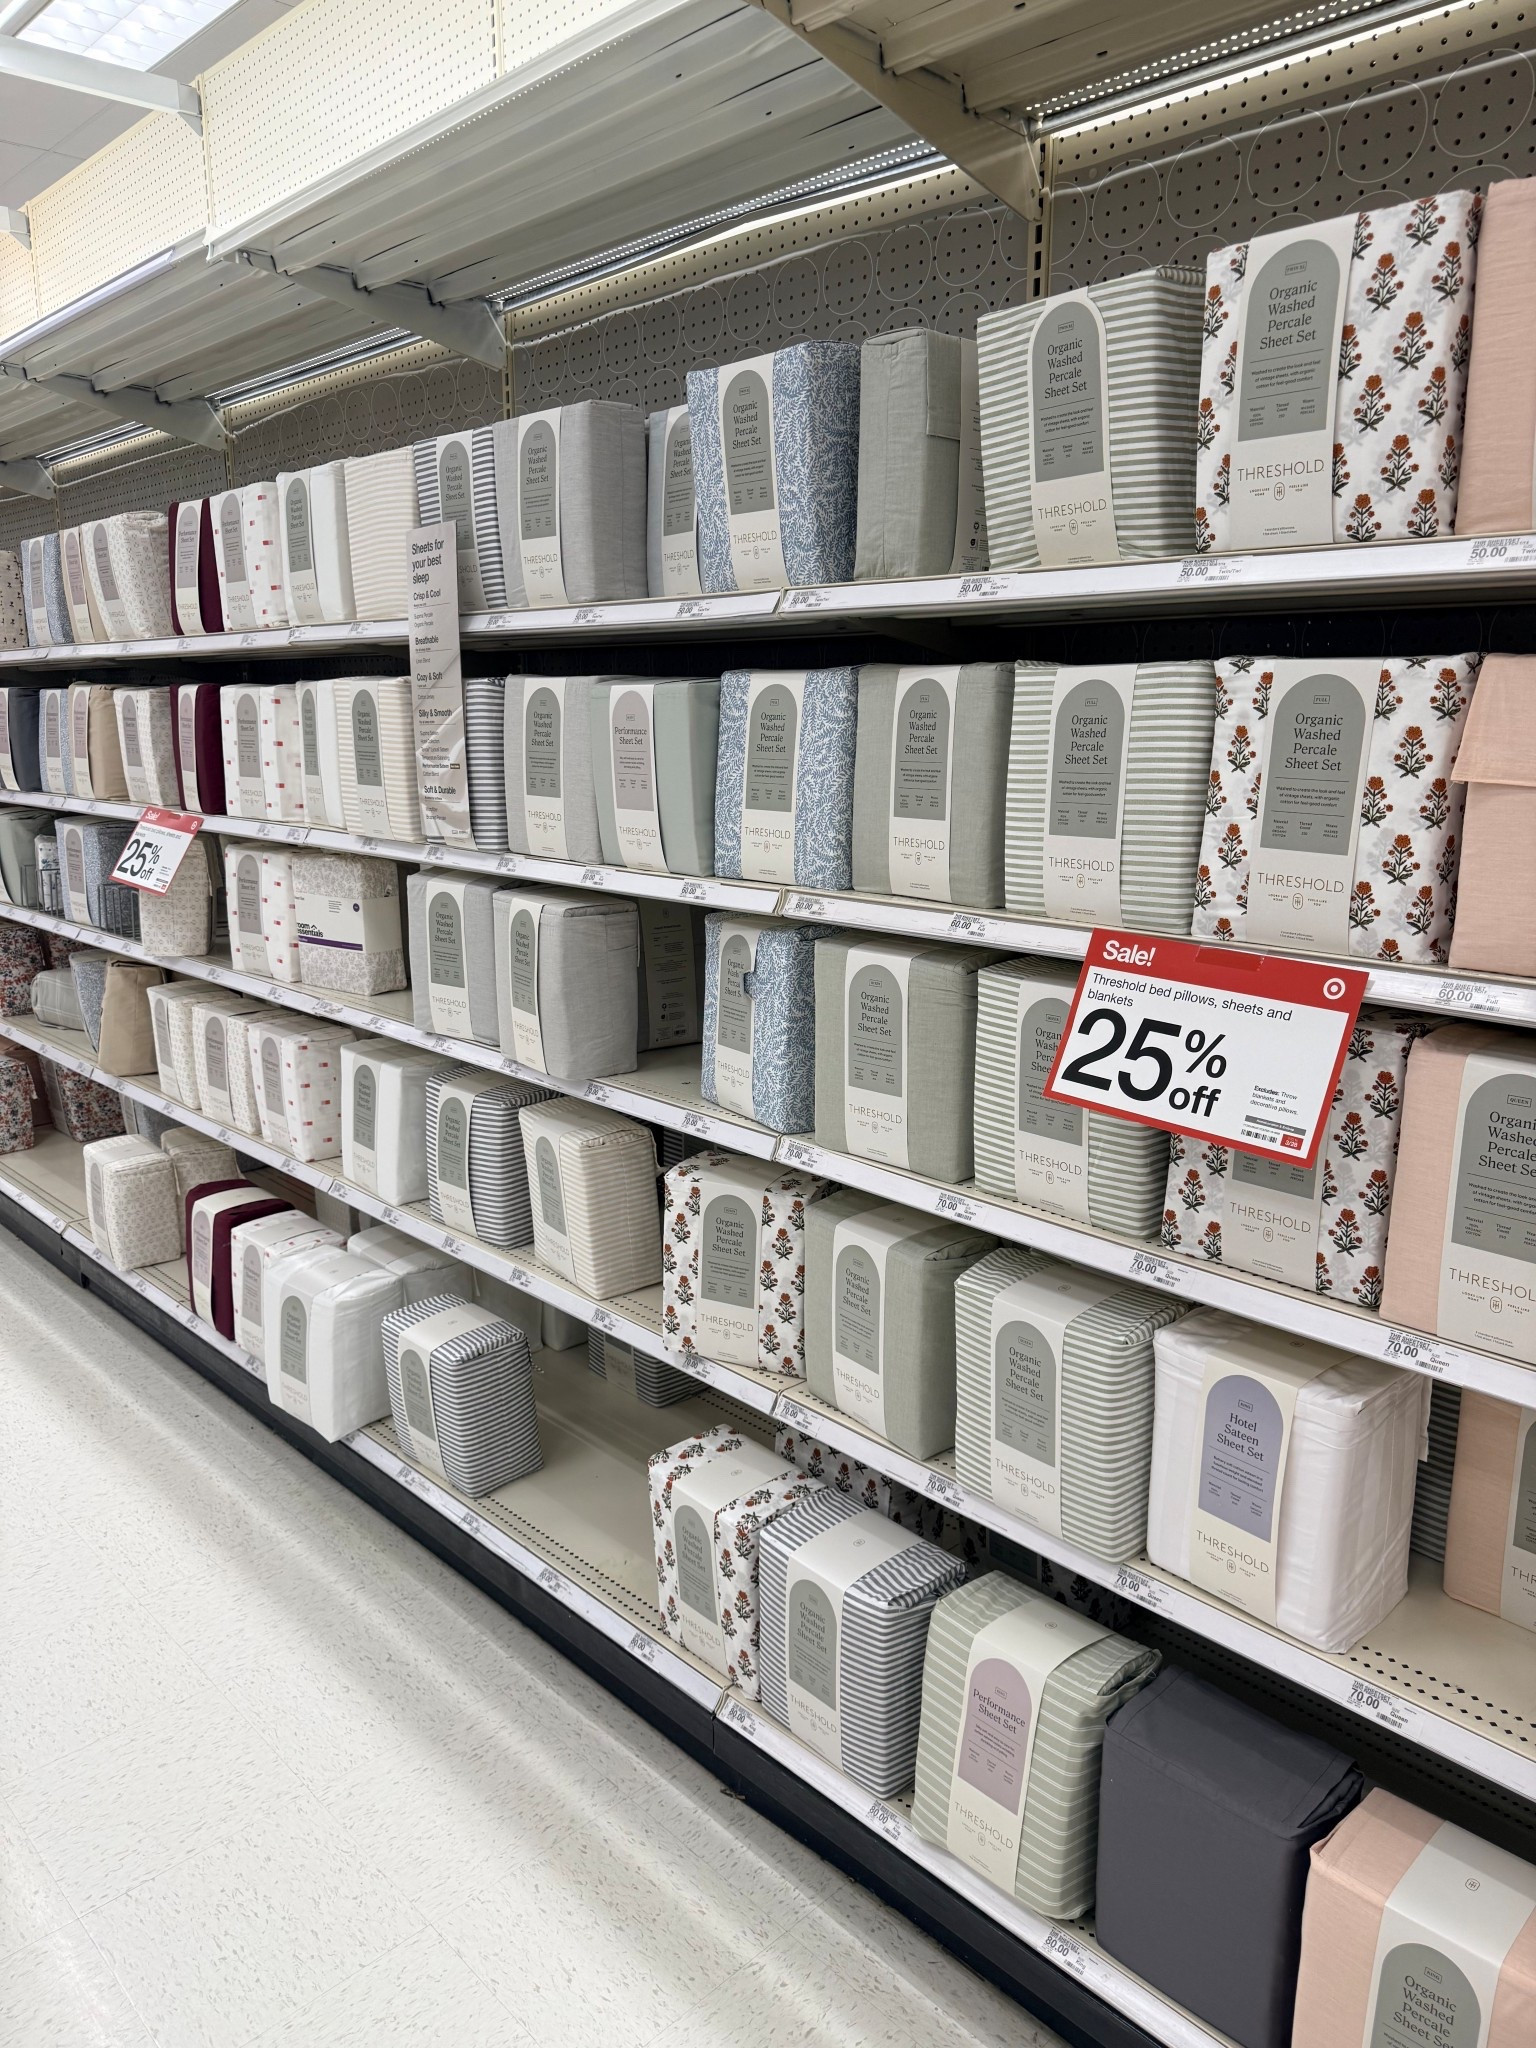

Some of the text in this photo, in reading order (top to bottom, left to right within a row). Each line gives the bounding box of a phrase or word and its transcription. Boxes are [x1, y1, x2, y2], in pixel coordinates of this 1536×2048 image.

[1270, 280, 1317, 300] Organic
[1268, 296, 1315, 315] Washed
[1268, 314, 1311, 332] Percale
[1048, 338, 1082, 355] Organic
[1260, 330, 1316, 349] Sheet Set
[1048, 352, 1082, 369] Washed
[1049, 367, 1082, 383] Percale
[1045, 381, 1087, 398] Sheet Set
[733, 401, 757, 415] Organic
[734, 412, 757, 425] Washed
[735, 425, 757, 437] Percale
[732, 436, 761, 450] Sheet Set
[1238, 459, 1324, 481] THRESHOLD
[1038, 499, 1107, 519] THRESHOLD
[733, 530, 777, 544] THRESHOLD
[412, 539, 444, 555] Sheets for
[1470, 547, 1507, 558] 50.00
[412, 554, 441, 572] your best
[413, 573, 429, 585] sleep
[1180, 567, 1208, 576] 50.00
[413, 592, 425, 601] Crisp
[430, 589, 441, 598] Cool
[960, 584, 982, 592] 50.00
[415, 636, 438, 645] Breathable
[417, 673, 428, 682] Cozy
[433, 672, 442, 680] Soft
[419, 709, 429, 718] Silky
[434, 709, 452, 717] Smooth
[909, 710, 937, 721] Organic
[1072, 715, 1108, 727] Organic
[1296, 713, 1343, 727] Organic
[909, 722, 936, 731] Washed
[1071, 728, 1106, 738] Washed
[1294, 728, 1341, 740] Washed
[909, 734, 934, 742] Percale
[1071, 741, 1104, 751] Percale
[905, 745, 938, 754] Sheet Set
[1294, 743, 1337, 755] Percale
[1065, 754, 1108, 764] Sheet Set
[1285, 758, 1341, 771] Sheet Set
[424, 786, 456, 794] Soft & Durable
[745, 827, 790, 839] THRESHOLD
[893, 837, 945, 850] THRESHOLD
[1049, 857, 1114, 872] THRESHOLD
[140, 868, 154, 880] off
[1257, 872, 1344, 893] THRESHOLD
[951, 920, 971, 929] 60.00
[1102, 939, 1156, 967] Sale!
[861, 992, 889, 1004] Organic
[1088, 989, 1134, 1008] blankets
[1093, 972, 1292, 1022] Threshold bed pillows, sheets and
[1439, 989, 1473, 1002] 60.00
[861, 1002, 888, 1014] Washed
[862, 1013, 888, 1025] Percale
[858, 1022, 892, 1036] Sheet Set
[1036, 1027, 1062, 1040] Organ
[1035, 1039, 1058, 1051] Wash
[1036, 1051, 1054, 1062] Perc
[1032, 1062, 1051, 1074] Shee
[1252, 1093, 1274, 1102] blankets
[1254, 1085, 1297, 1100] Excludes: Throw
[1168, 1085, 1222, 1118] off
[1250, 1100, 1298, 1115] decorative pillows.
[849, 1104, 902, 1124] THRESHOLD
[1490, 1111, 1536, 1130] Organi
[1019, 1150, 1082, 1176] THRESHOLD
[1478, 1155, 1536, 1177] Sheet Se
[938, 1198, 957, 1210] 70.00
[716, 1217, 744, 1229] Organic
[1230, 1202, 1311, 1233] THRESHOLD
[716, 1226, 743, 1238] Washed
[716, 1235, 742, 1247] Percale
[712, 1244, 746, 1256] Sheet Set
[1132, 1259, 1156, 1274] 70.00
[846, 1267, 869, 1285] Organic
[846, 1277, 869, 1295] Washed
[1449, 1267, 1536, 1302] THRESHOL
[847, 1288, 868, 1304] Percale
[843, 1296, 871, 1316] Sheet Set
[701, 1314, 753, 1331] THRESHOLD
[1387, 1340, 1418, 1357] 70.00
[1009, 1347, 1041, 1367] Organic
[1430, 1357, 1449, 1367] Queen
[1009, 1357, 1041, 1378] Washed
[836, 1368, 879, 1399] THRESHOLD
[1010, 1369, 1039, 1389] Percale
[1006, 1378, 1043, 1402] Sheet Set
[1230, 1412, 1257, 1432] Hotel
[1224, 1424, 1259, 1446] Sateen
[1217, 1433, 1263, 1461] Sheet Set
[995, 1458, 1055, 1494] THRESHOLD
[926, 1479, 946, 1494] 70.00
[1197, 1530, 1269, 1574] THRESHOLD
[1117, 1574, 1139, 1591] 70.00
[800, 1601, 825, 1624] Organic
[800, 1611, 825, 1634] Washed
[801, 1621, 824, 1642] Percale
[797, 1628, 827, 1654] Sheet Set
[1351, 1688, 1379, 1709] 70.00
[791, 1694, 836, 1733] THRESHOLD
[973, 1688, 1026, 1727] Performance
[978, 1704, 1017, 1734] Sheet Set
[870, 1806, 888, 1824] 80.00
[955, 1801, 1013, 1849] THRESHOLD
[1046, 1936, 1069, 1956] 80.00
[1427, 1970, 1439, 1980] KING
[1405, 1975, 1456, 2012] Organic
[1403, 1987, 1454, 2025] Washed
[1393, 2011, 1431, 2040] Sheet
[1403, 2002, 1450, 2037] Percale
